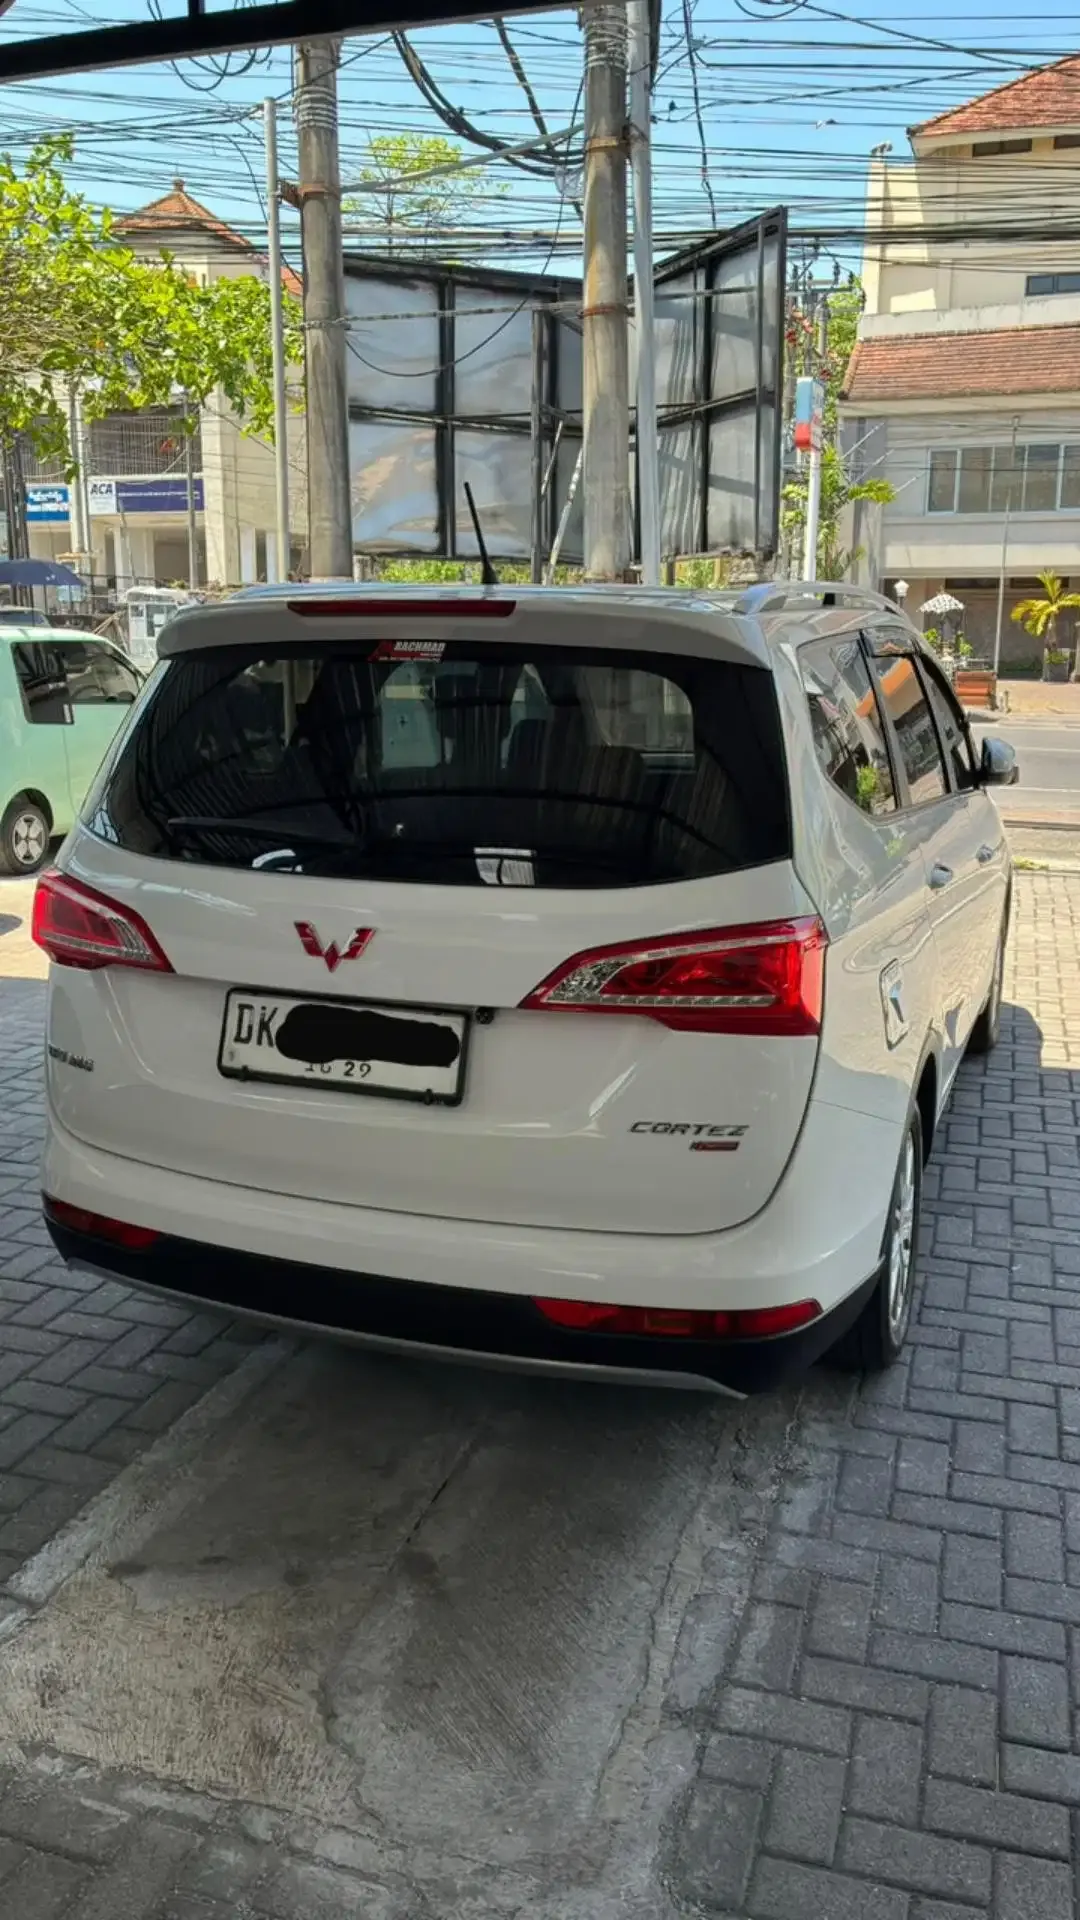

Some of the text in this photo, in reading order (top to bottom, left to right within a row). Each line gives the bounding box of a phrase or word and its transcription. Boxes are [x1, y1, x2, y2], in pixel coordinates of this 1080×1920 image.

[233, 1003, 278, 1047] DK
[343, 1061, 372, 1078] 29
[630, 1121, 749, 1136] CORTEZ
